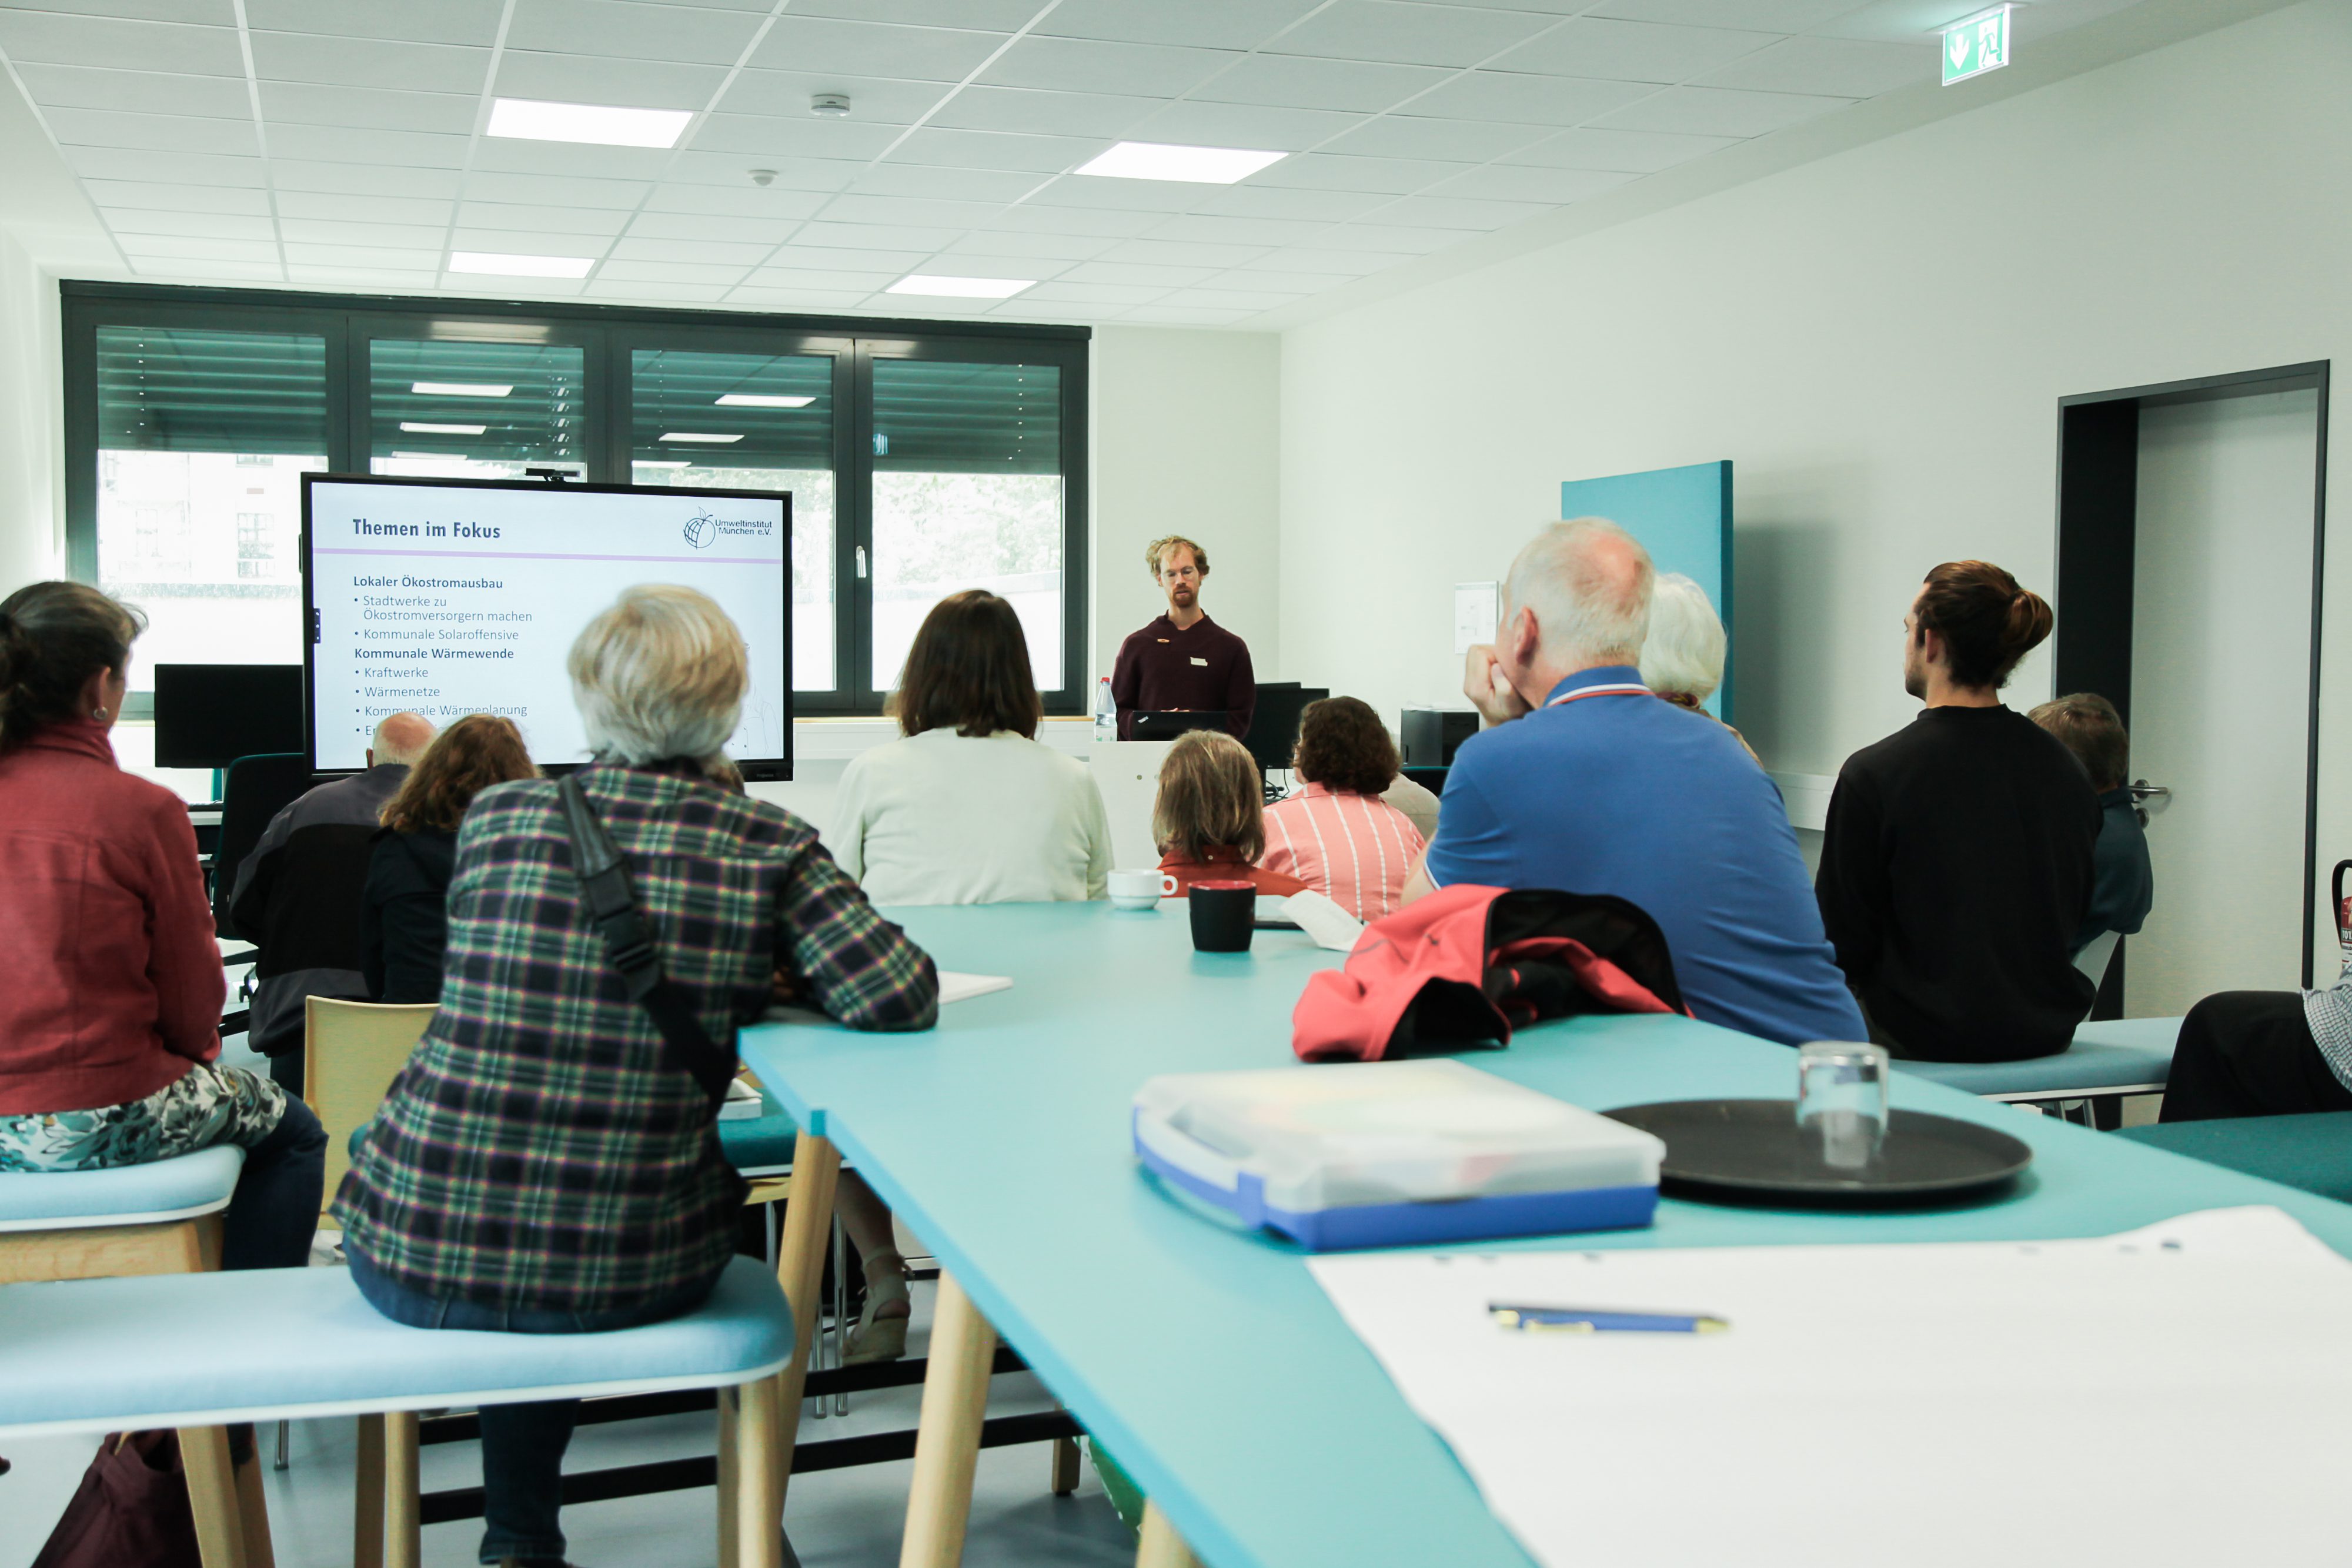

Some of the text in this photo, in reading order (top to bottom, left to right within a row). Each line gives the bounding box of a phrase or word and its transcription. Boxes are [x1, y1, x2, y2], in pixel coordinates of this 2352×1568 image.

[352, 518, 500, 539] Themen im Fokus
[715, 520, 772, 528] Umweltinstitut
[354, 574, 503, 589] Lokaler Ökostromausbau
[363, 595, 446, 607] Stadtwerke zu
[363, 607, 532, 623] Ökostromversorgern machen
[364, 628, 519, 640] Kommunale Solaroffensive
[355, 648, 514, 658] Kommunale Wärmewende
[365, 667, 429, 678] Kraftwerke
[365, 687, 440, 697] Wärmenetze
